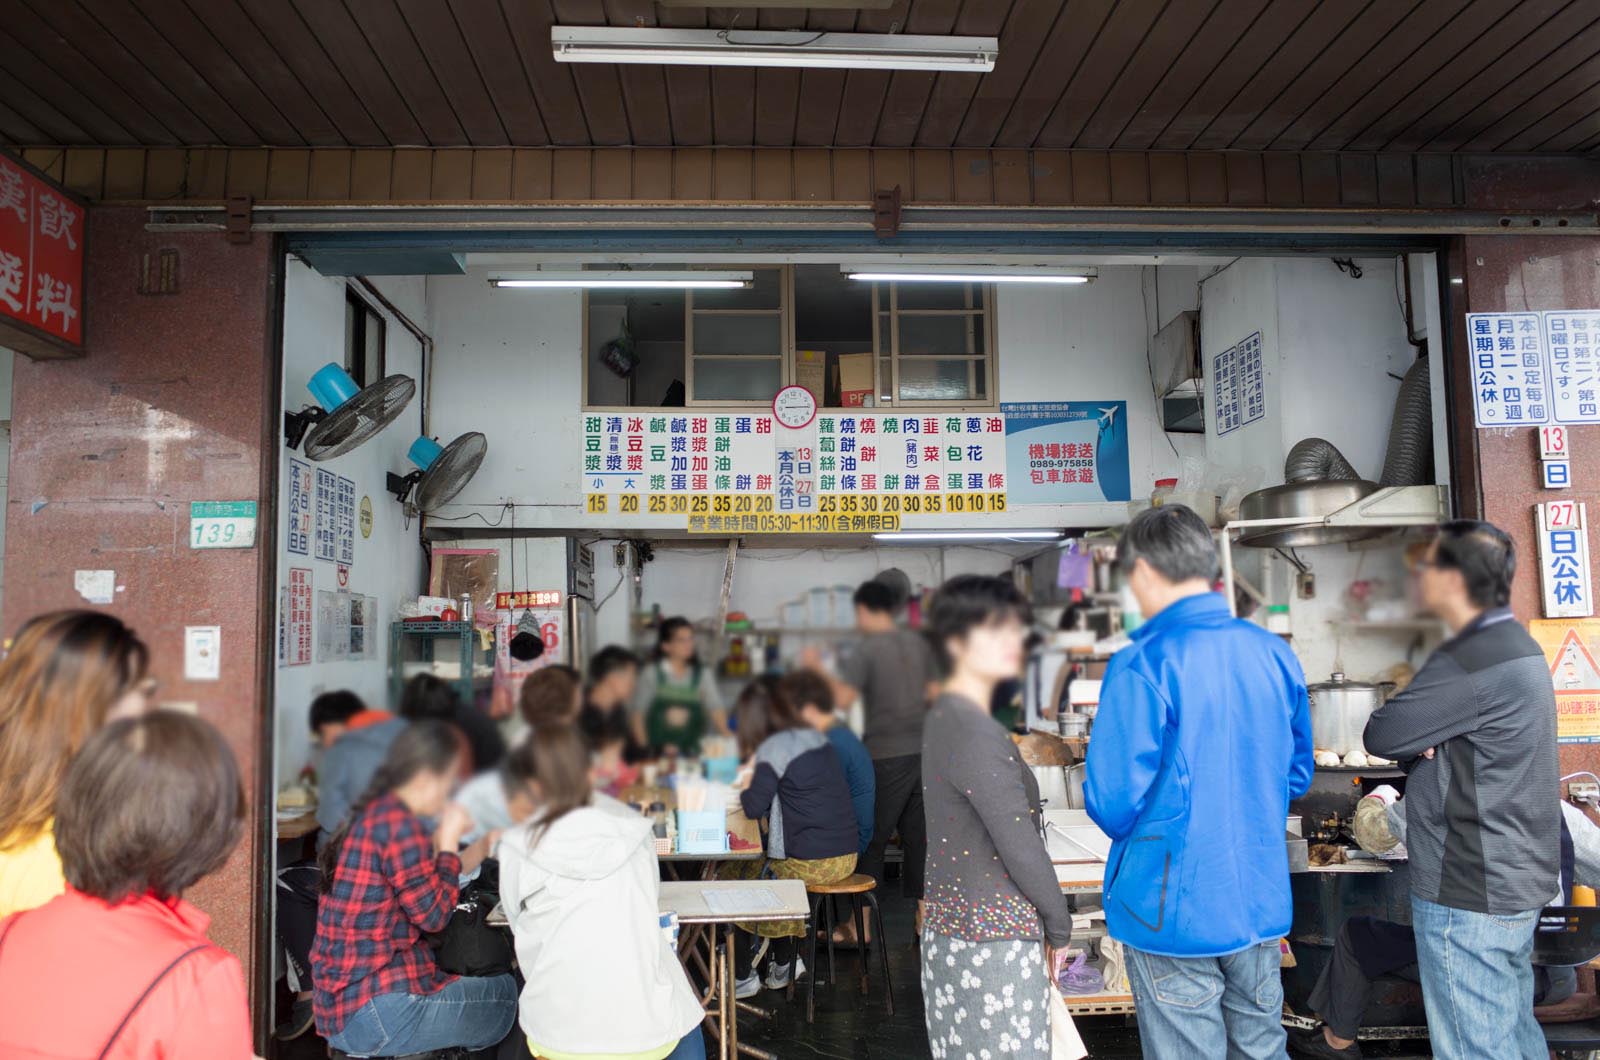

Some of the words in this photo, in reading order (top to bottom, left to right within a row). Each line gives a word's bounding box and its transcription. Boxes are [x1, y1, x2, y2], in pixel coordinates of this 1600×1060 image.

[36, 194, 77, 334] 飲料
[1474, 319, 1498, 417] 星期日公休。
[1497, 319, 1522, 420] 月第二、四週
[1518, 318, 1545, 419] 本店固定每個
[1551, 318, 1572, 400] 日曜日です。
[585, 417, 601, 470] 甜豆漿
[627, 417, 643, 470] 冰豆漿
[650, 417, 666, 490] 鹹豆漿
[670, 417, 687, 490] 鹹漿加蛋
[691, 417, 708, 490] 甜漿加蛋
[714, 417, 731, 490] 蛋餅油條
[735, 417, 752, 490] 蛋餅
[756, 418, 772, 490] 甜餅
[819, 418, 836, 490] 蘿蔔絲餅
[840, 418, 857, 490] 燒餅油條
[860, 418, 877, 490] 燒餅蛋
[883, 418, 900, 490] 燒餅
[946, 417, 963, 490] 荷包蛋
[986, 417, 1004, 490] 油條
[1029, 443, 1093, 459] 機場接送
[1030, 459, 1093, 468] 0989-975858
[1030, 467, 1094, 484] 包車旅遊
[290, 464, 300, 549] 本月公休日
[589, 495, 605, 511] 15
[621, 495, 638, 511] 20
[650, 495, 666, 511] 25
[670, 495, 687, 511] 30
[692, 495, 708, 511] 25
[714, 495, 731, 511] 35
[735, 495, 751, 511] 20
[756, 495, 772, 511] 20
[820, 495, 836, 511] 25
[841, 495, 857, 511] 35
[861, 495, 877, 511] 30
[883, 495, 900, 511] 20
[904, 495, 920, 511] 30
[924, 495, 940, 511] 35
[947, 495, 963, 511] 10
[968, 495, 984, 511] 10
[989, 495, 1005, 511] 15
[593, 478, 604, 489] 小
[624, 478, 635, 489] 大
[778, 451, 794, 509] 本月公休日
[194, 522, 235, 545] 139
[689, 515, 757, 531] 營業時間
[761, 515, 829, 530] 05:30~11:30
[832, 513, 900, 531] (含例假日)
